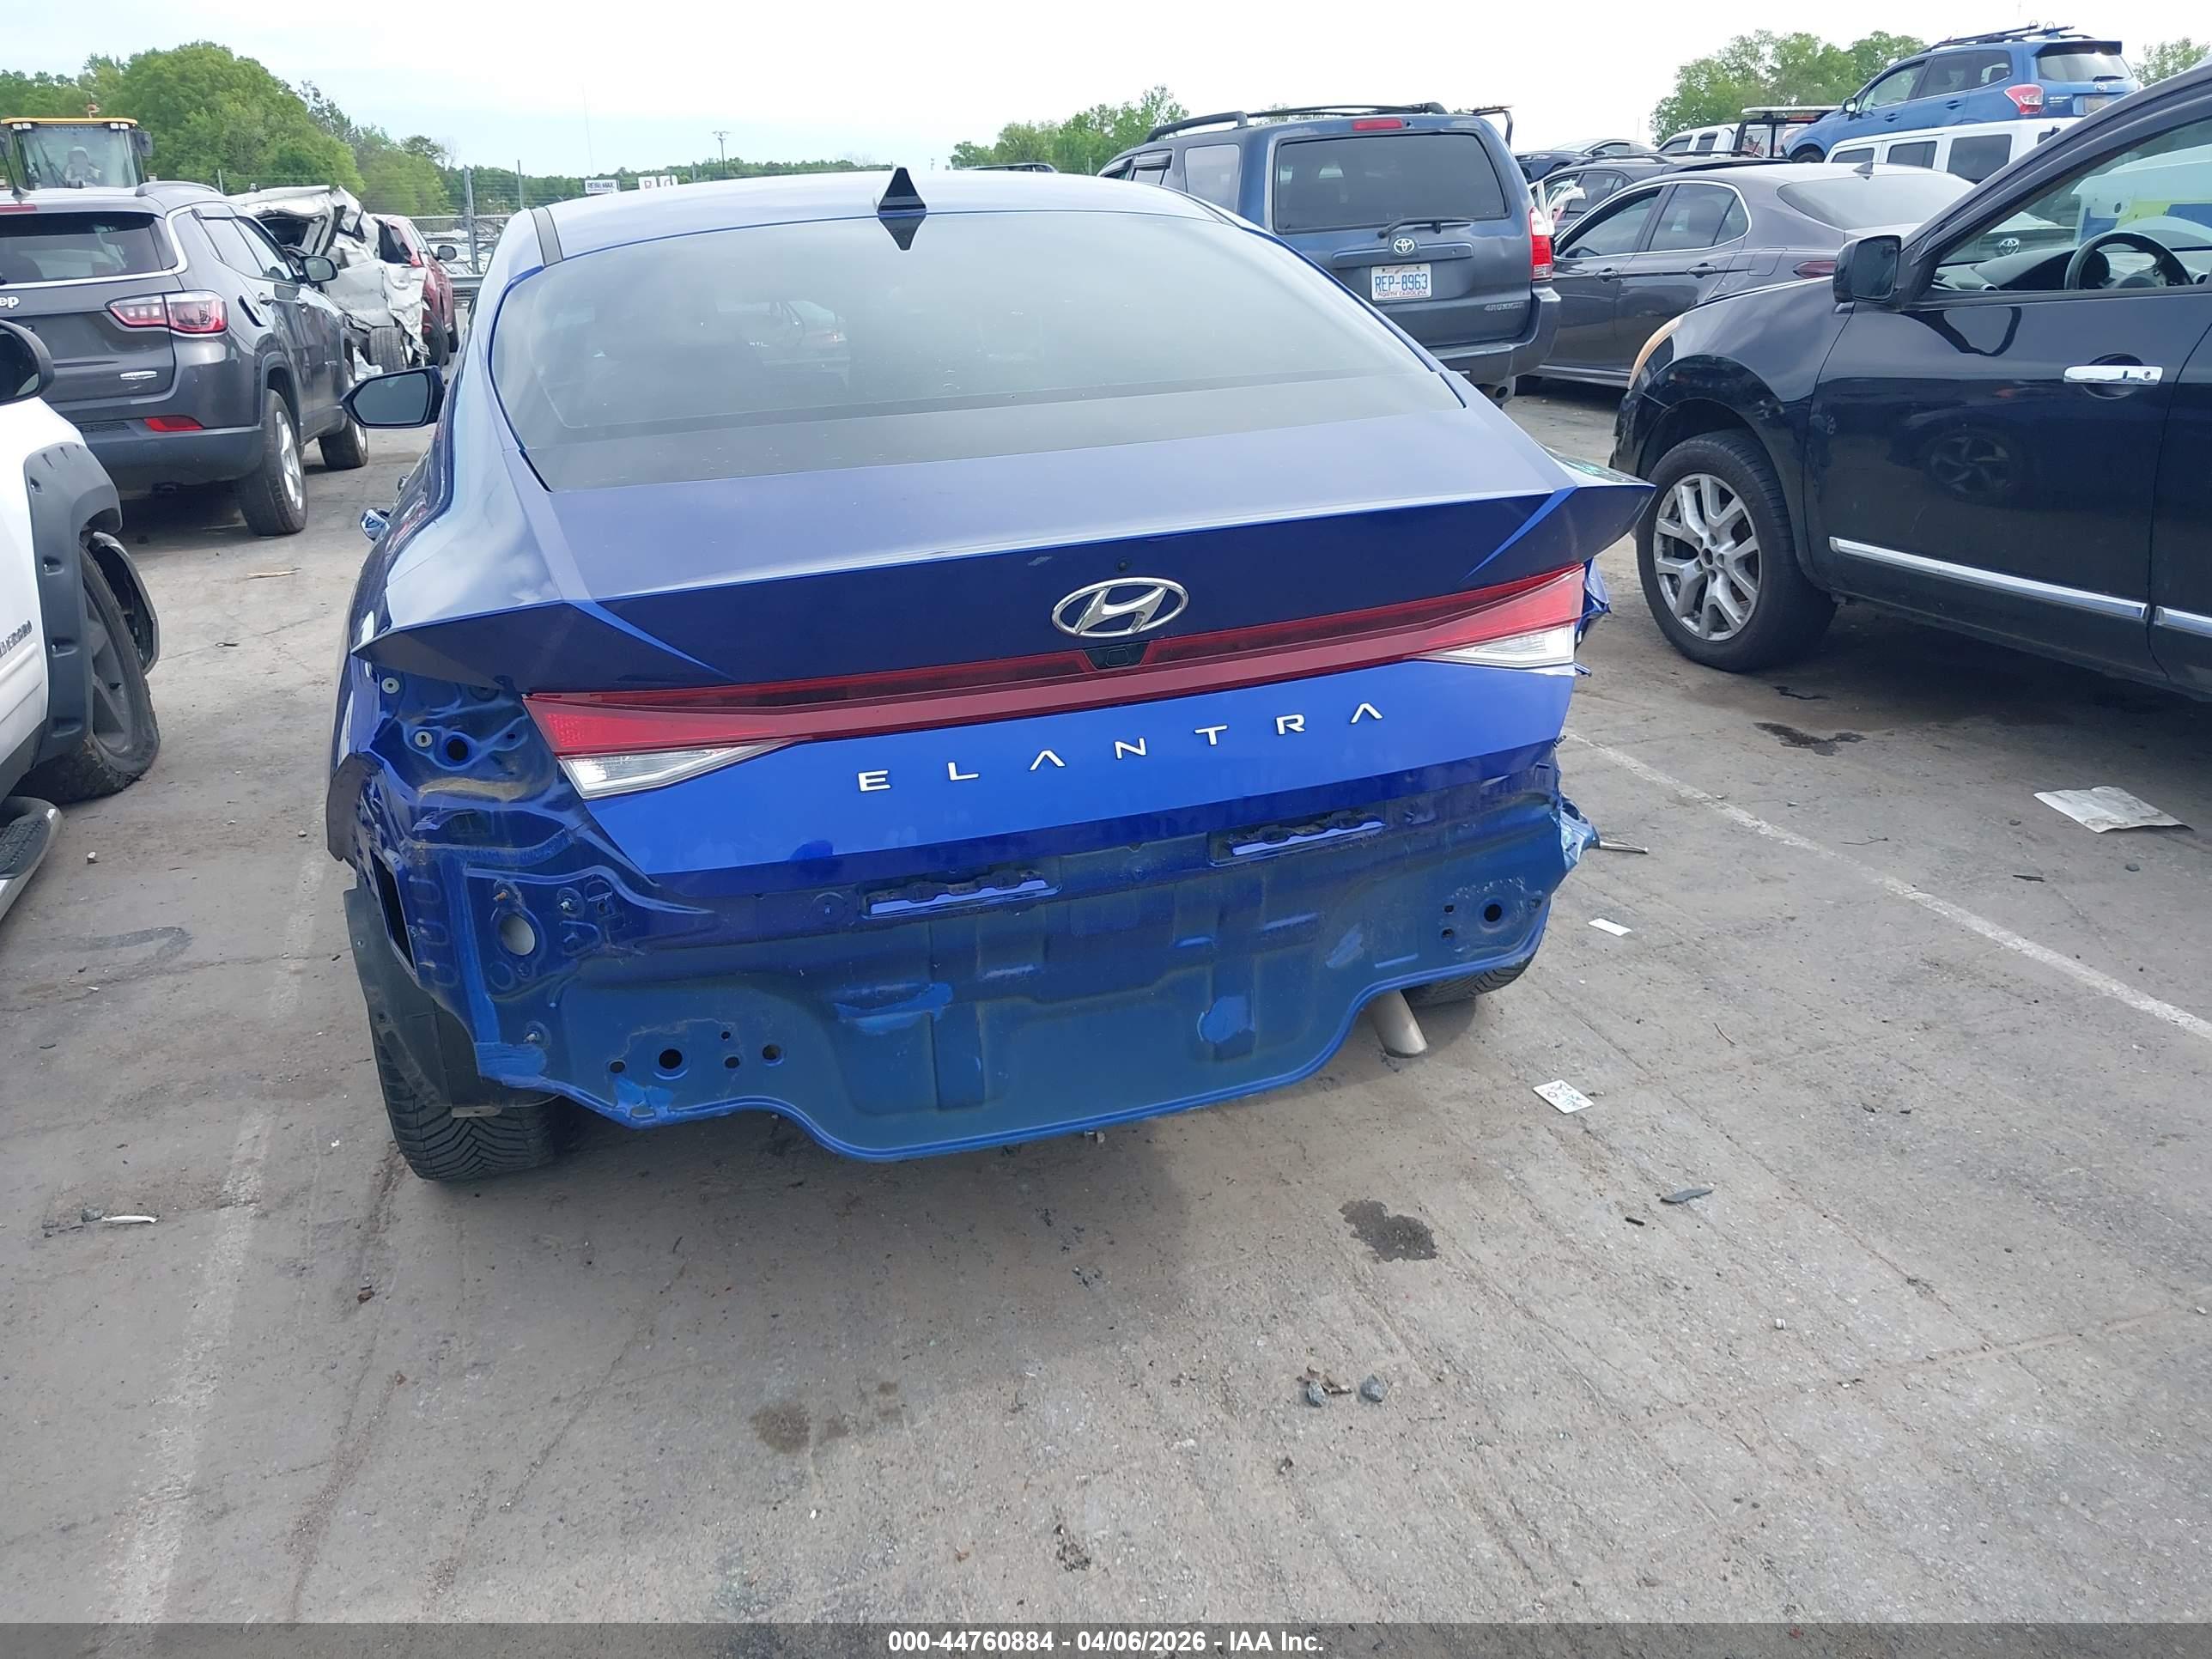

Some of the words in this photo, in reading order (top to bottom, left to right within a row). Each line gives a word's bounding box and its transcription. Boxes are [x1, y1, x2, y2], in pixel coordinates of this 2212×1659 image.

[1375, 273, 1428, 292] REP-8963
[0, 296, 20, 309] ep
[858, 702, 1383, 792] ELANTRA
